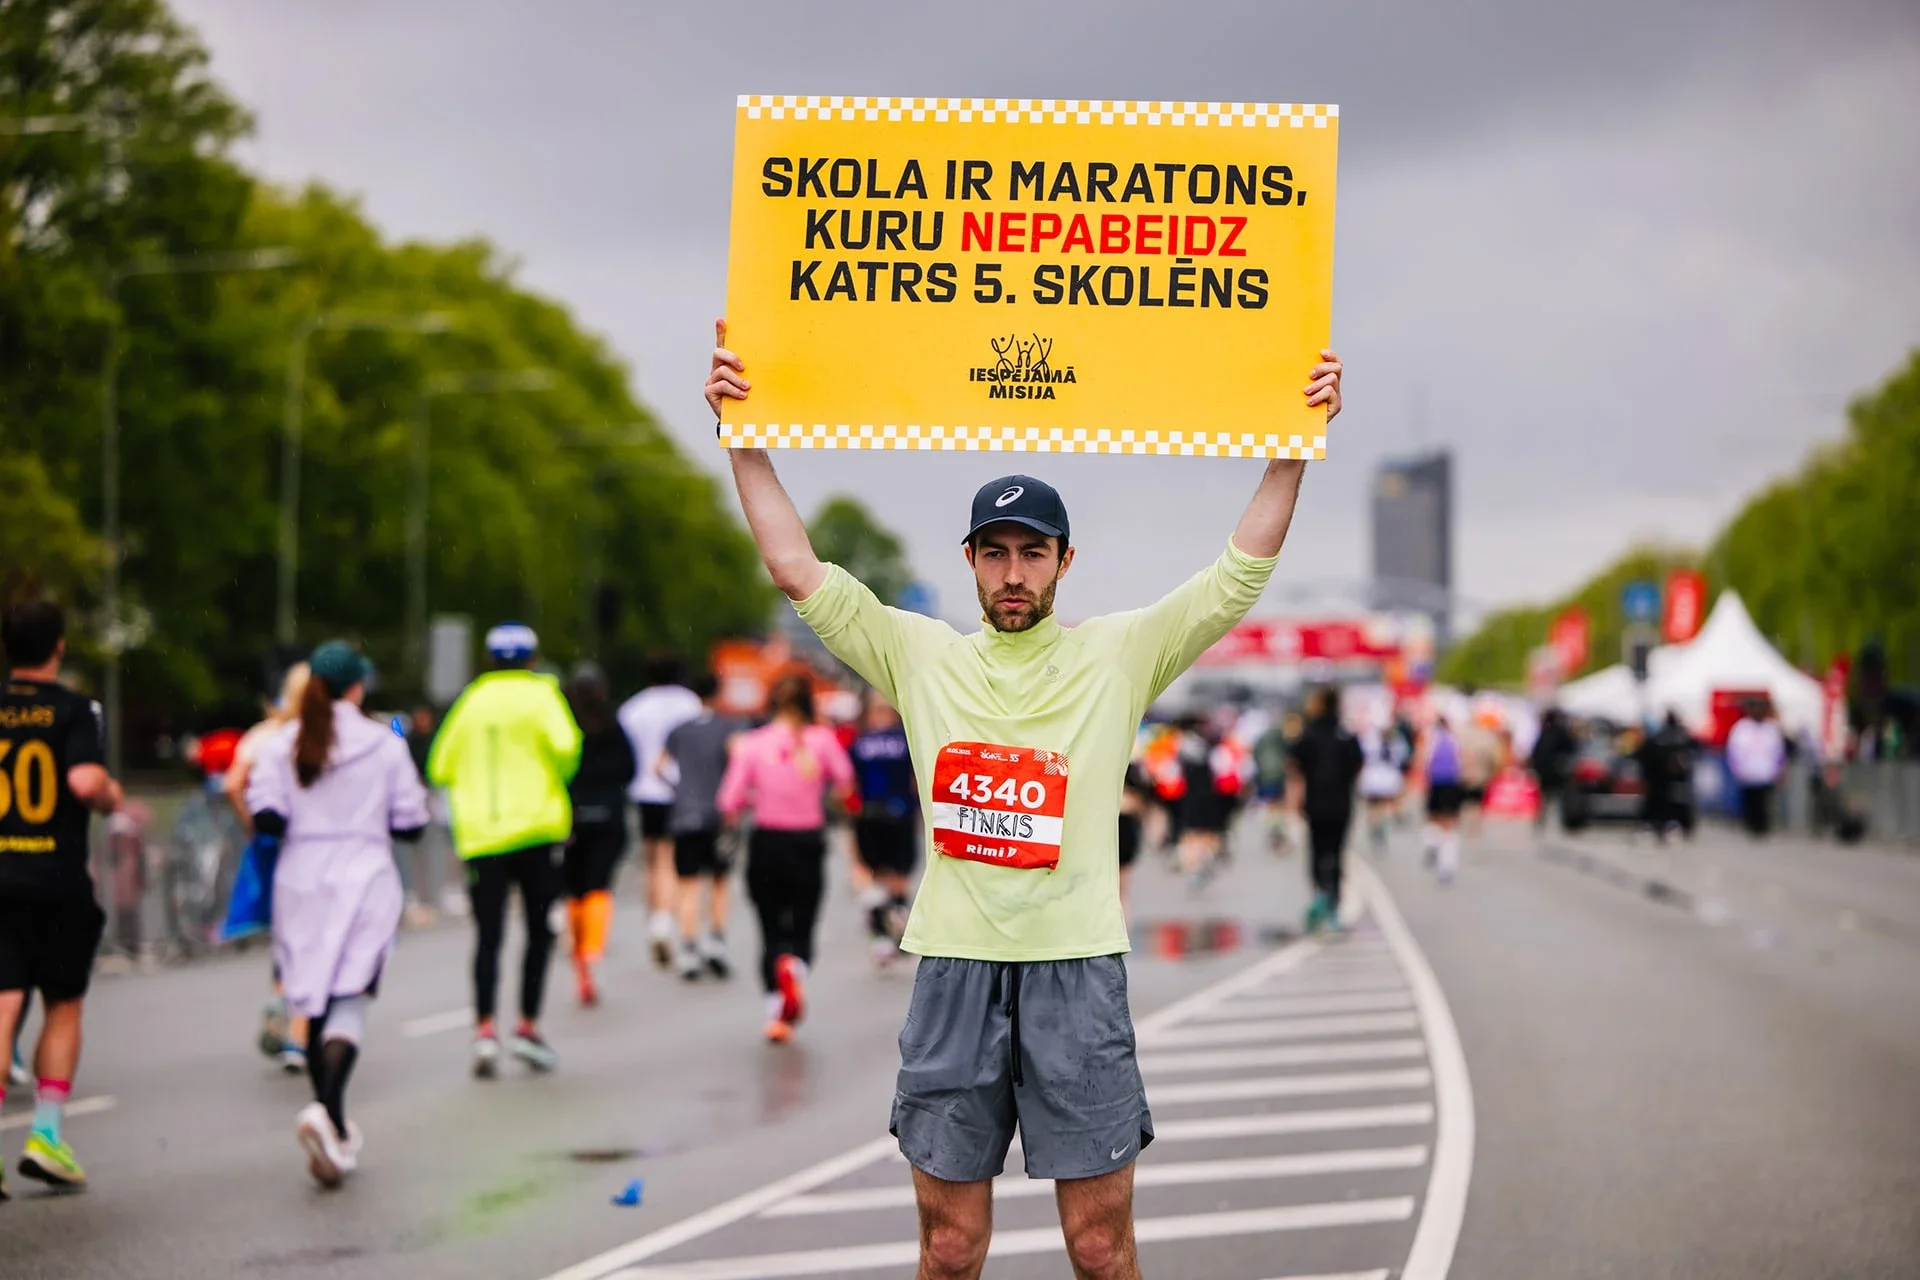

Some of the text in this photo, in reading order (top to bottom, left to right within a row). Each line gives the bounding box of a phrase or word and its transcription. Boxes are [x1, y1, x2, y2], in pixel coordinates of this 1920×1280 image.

[762, 157, 1307, 206] SKOLA IR MARATONS,
[805, 209, 1248, 257] KURU NEPABEIDZ
[790, 257, 1269, 309] KATRS 5. SKOLĒNS
[969, 365, 1077, 383] IESPĒJAMĀ
[988, 385, 1056, 399] MISIJA
[0, 739, 58, 824] 0
[949, 772, 1046, 809] 4340
[966, 844, 1005, 858] Rimi
